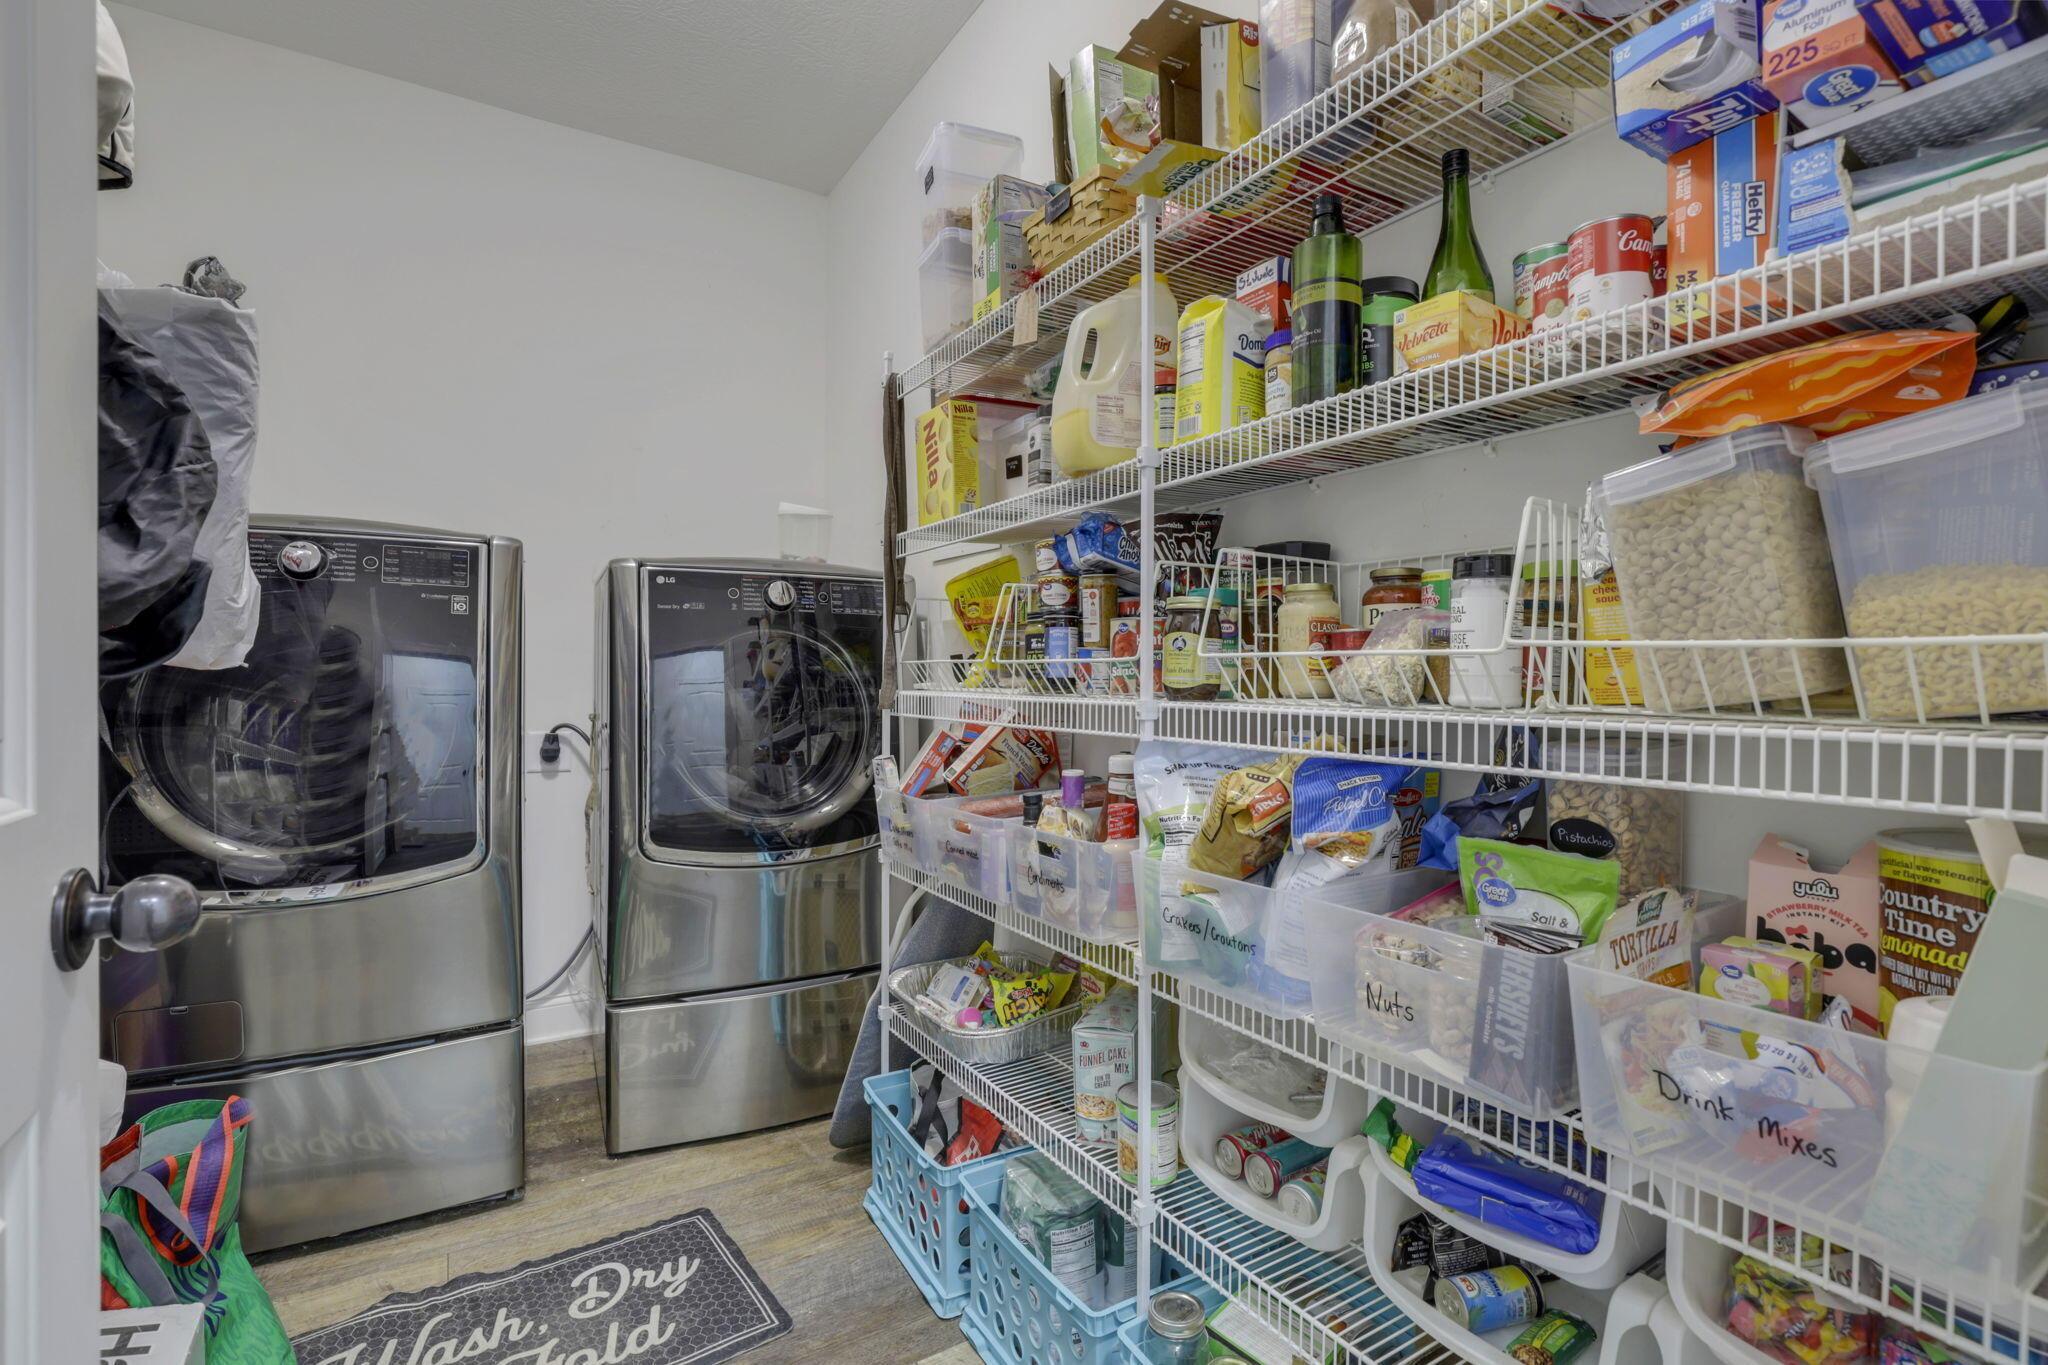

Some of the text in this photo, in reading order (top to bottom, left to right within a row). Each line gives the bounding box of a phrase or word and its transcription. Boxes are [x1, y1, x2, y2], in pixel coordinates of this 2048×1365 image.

[1782, 0, 1848, 32] Aluminum
[1803, 17, 1831, 33] Foil
[1768, 33, 1858, 77] 225 SQ FT
[1720, 180, 1731, 248] QUART SLIDER
[1731, 182, 1743, 243] FREEZER
[1744, 184, 1763, 233] Hefty
[954, 404, 974, 413] Nilla
[923, 417, 940, 489] Nilla
[665, 576, 676, 584] LG
[1001, 737, 1022, 762] French
[1340, 775, 1380, 789] SNACK FACTORY
[1557, 828, 1614, 849] Pistachios
[1027, 865, 1066, 894] Condiments
[1892, 869, 1942, 885] or flavors
[1915, 864, 1990, 886] sweeteners
[1481, 883, 1510, 897] Great
[1487, 891, 1508, 903] Value
[1793, 878, 1839, 899] yulu
[1531, 911, 1569, 928] Salt &
[1766, 902, 1870, 939] STRAWBERRY MILK TEA
[1785, 912, 1846, 929] INSTANT KIT
[1884, 908, 1958, 948] Time
[1211, 926, 1257, 956] Croutons
[1609, 919, 1679, 970] TORTILLA
[1897, 962, 1951, 988] DRINK MIX WITH
[1366, 982, 1414, 1022] Nuts
[1079, 1047, 1128, 1068] FUNNEL CAKE
[1114, 1062, 1130, 1074] MIX
[1652, 1069, 1838, 1168] Drink Mixes
[1052, 1221, 1094, 1237] Nutrition Facts
[568, 1256, 701, 1320] Dry
